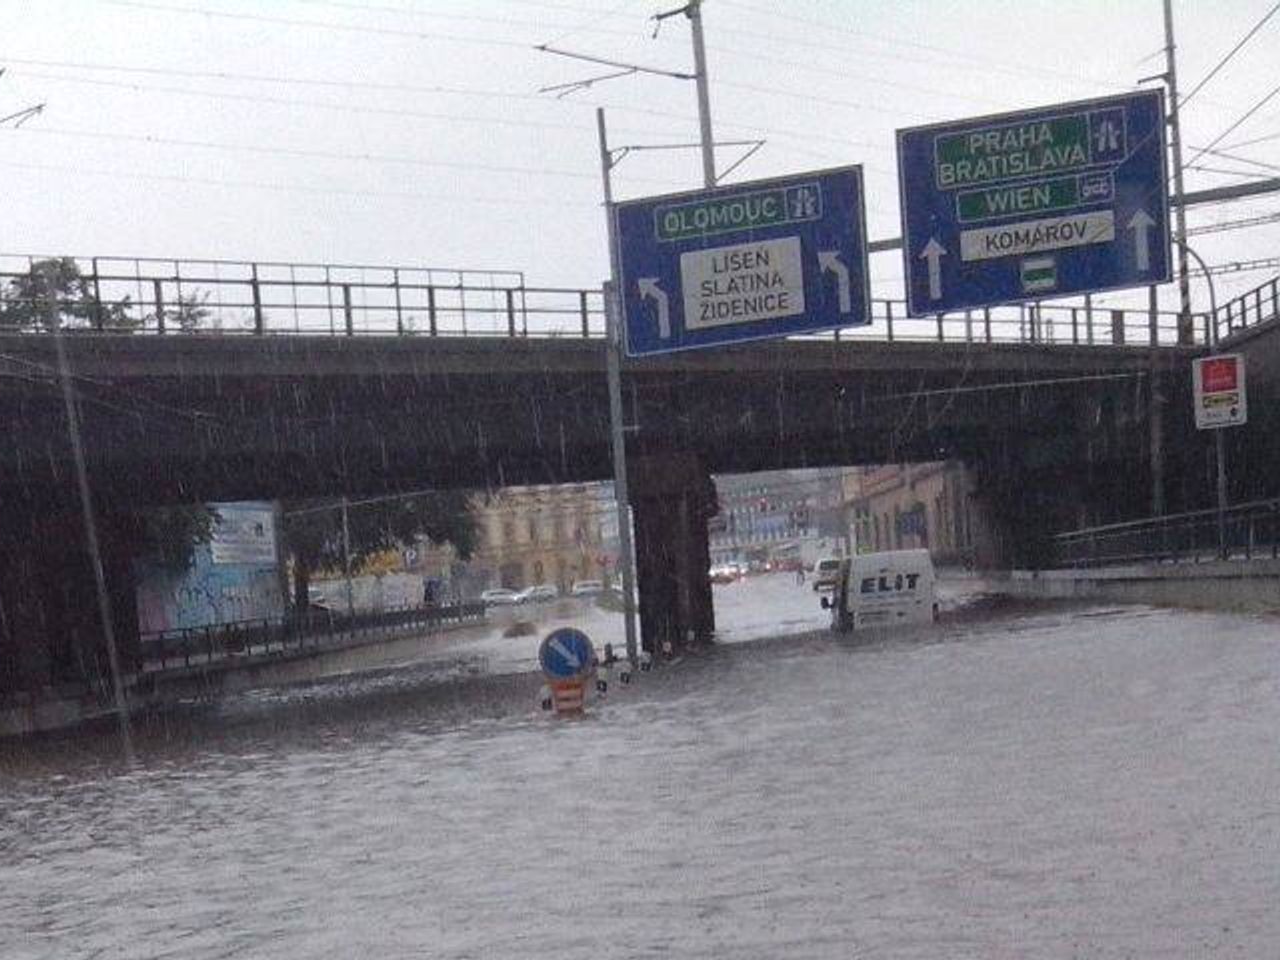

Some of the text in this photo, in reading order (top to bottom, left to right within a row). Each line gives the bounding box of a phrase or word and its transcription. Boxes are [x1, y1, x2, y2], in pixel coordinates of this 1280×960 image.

[969, 123, 1054, 153] PRAHA
[940, 146, 1087, 184] BRATISLAVA
[985, 185, 1051, 212] WIEN
[663, 197, 777, 232] OLOMOUC
[701, 271, 785, 297] SLATINA
[861, 573, 920, 593] ELIT
